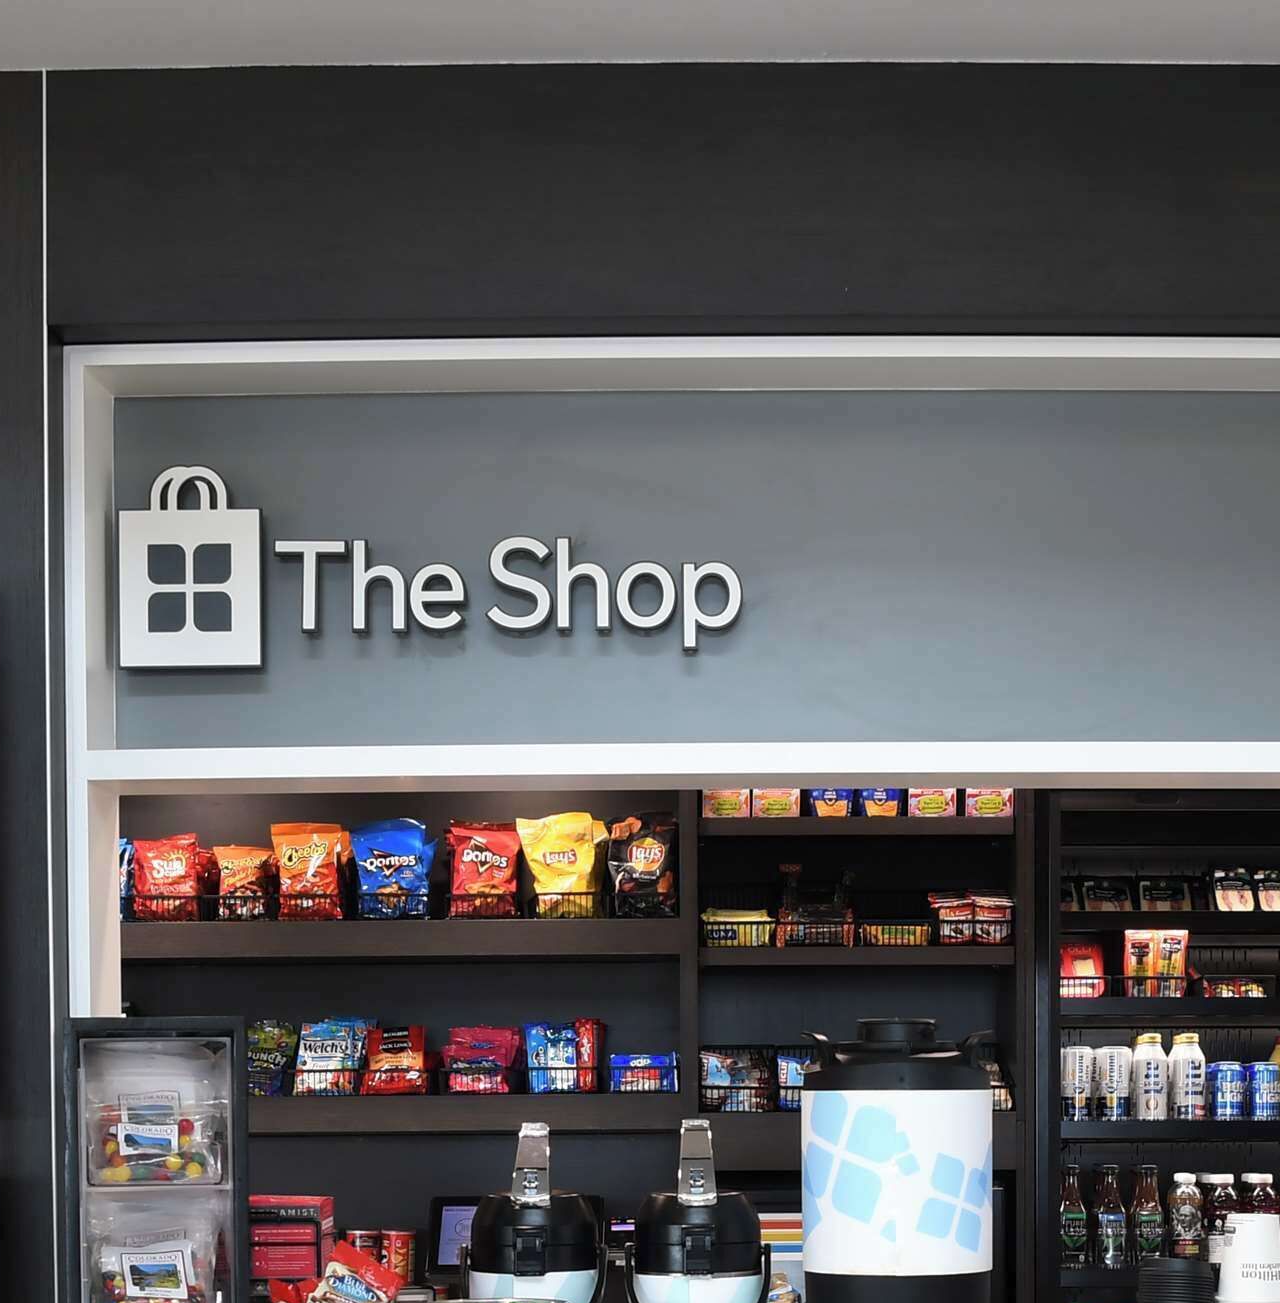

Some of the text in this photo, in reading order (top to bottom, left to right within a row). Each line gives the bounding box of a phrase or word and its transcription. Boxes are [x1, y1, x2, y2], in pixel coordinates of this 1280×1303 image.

[274, 535, 743, 653] The Shop
[281, 842, 328, 867] Cheetos
[363, 853, 417, 872] Doritos
[461, 848, 509, 869] Doritos
[303, 1041, 345, 1057] Welch's
[1241, 1270, 1279, 1281] Hilton
[328, 1277, 378, 1303] DIAMOND
